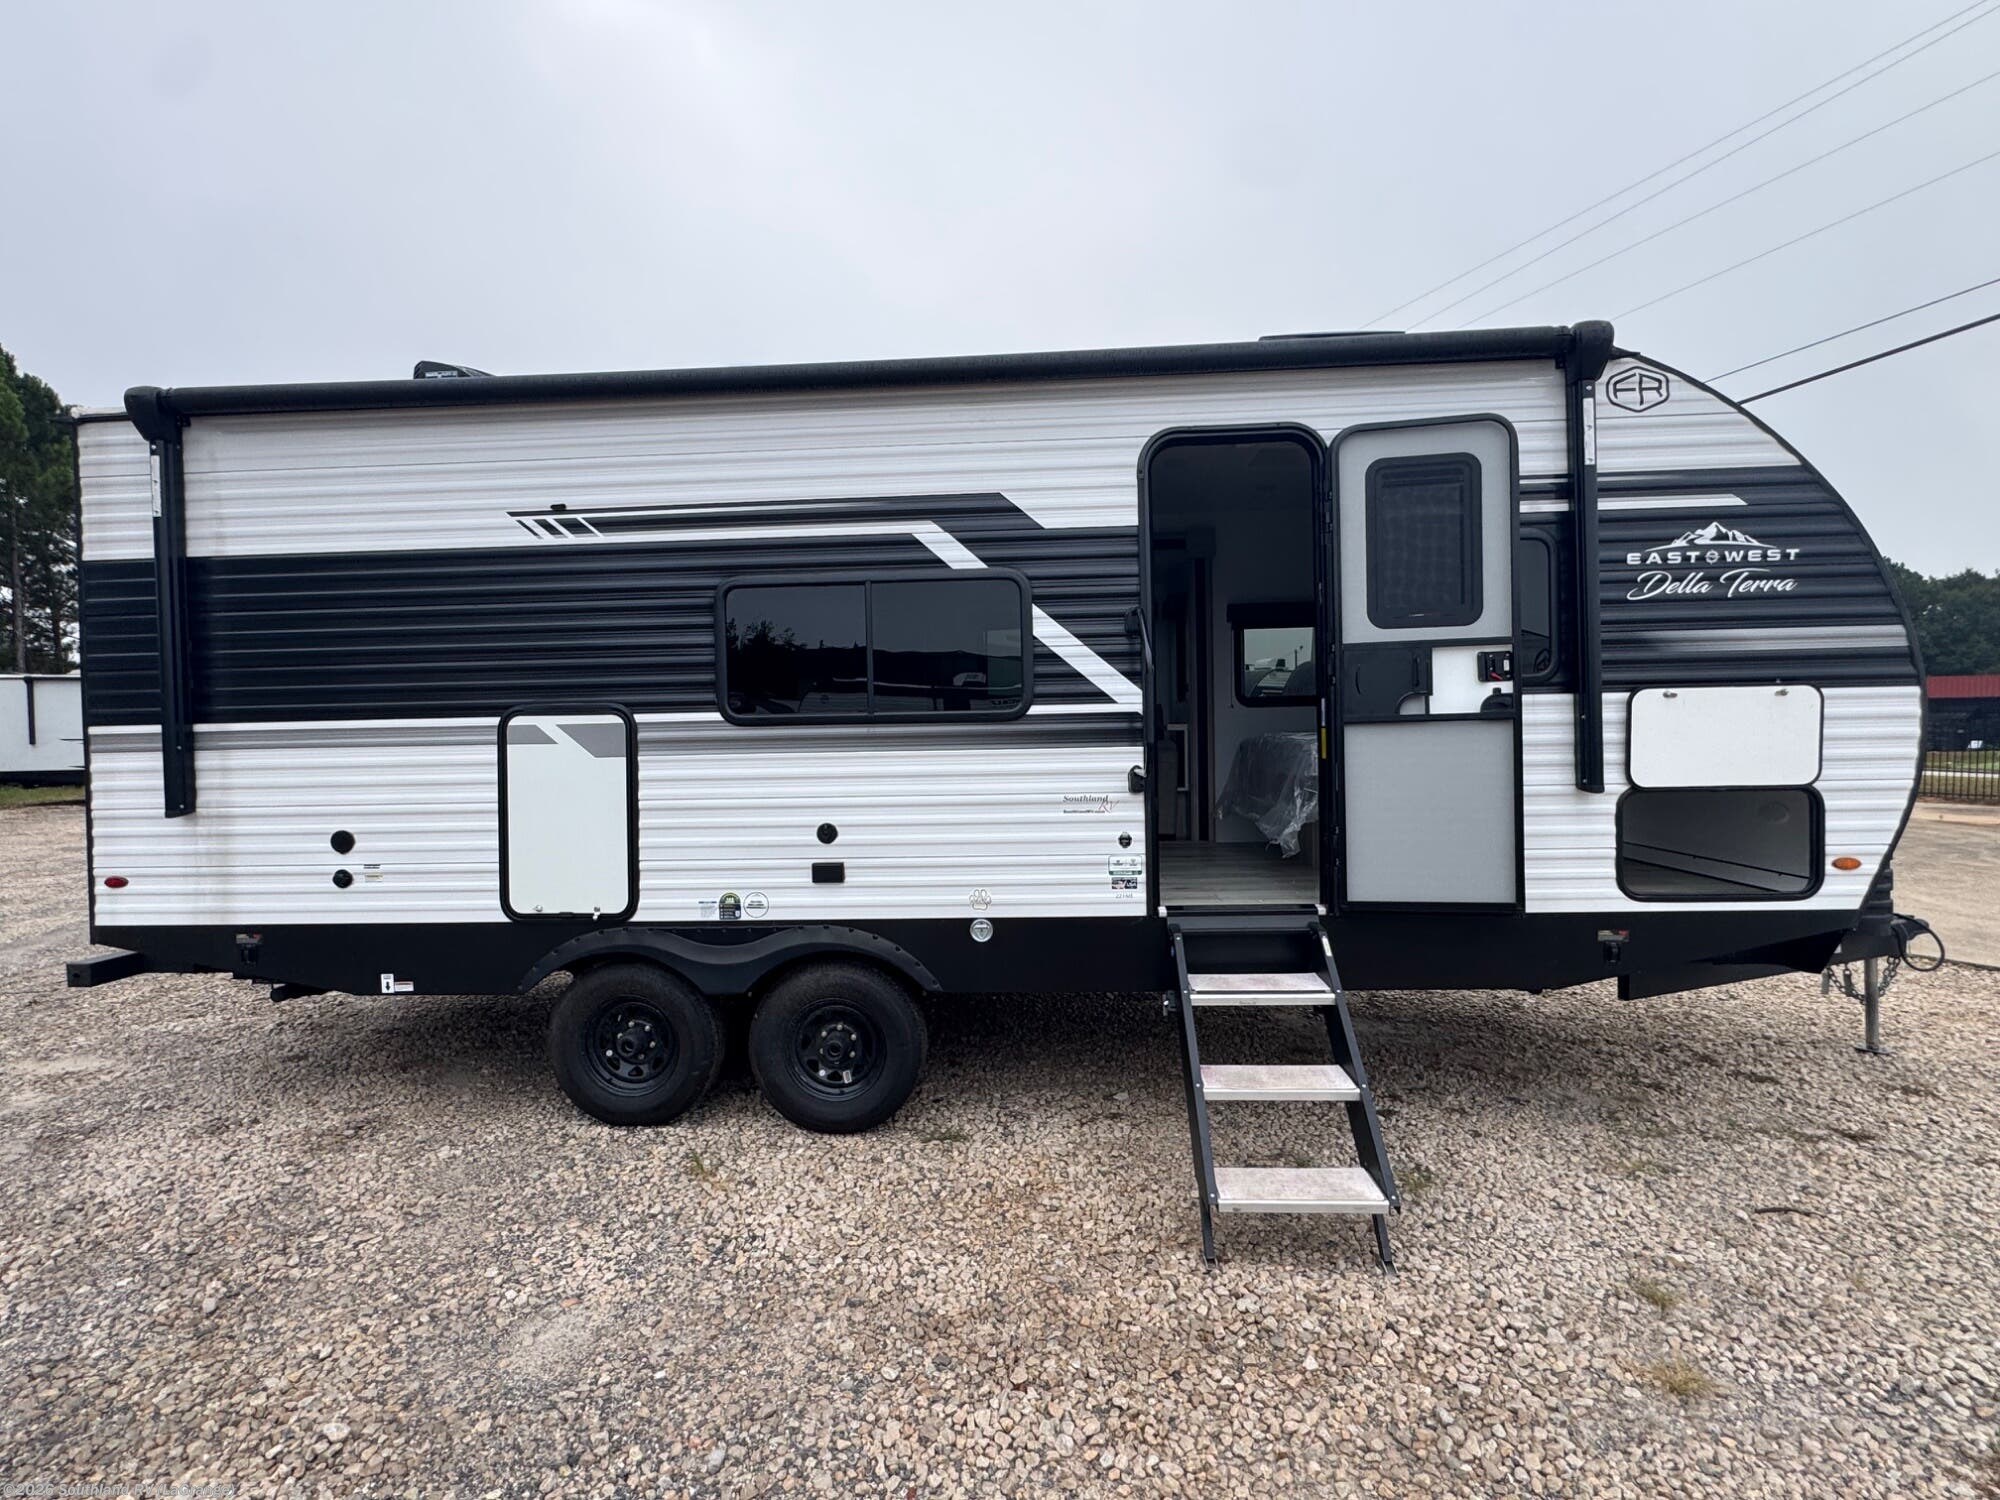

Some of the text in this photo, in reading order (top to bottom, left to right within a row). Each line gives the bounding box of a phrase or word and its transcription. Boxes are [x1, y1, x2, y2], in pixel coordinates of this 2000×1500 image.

[1626, 549, 1800, 565] EAST WEST
[1626, 567, 1798, 601] Della Terra
[1062, 794, 1109, 804] Southland
